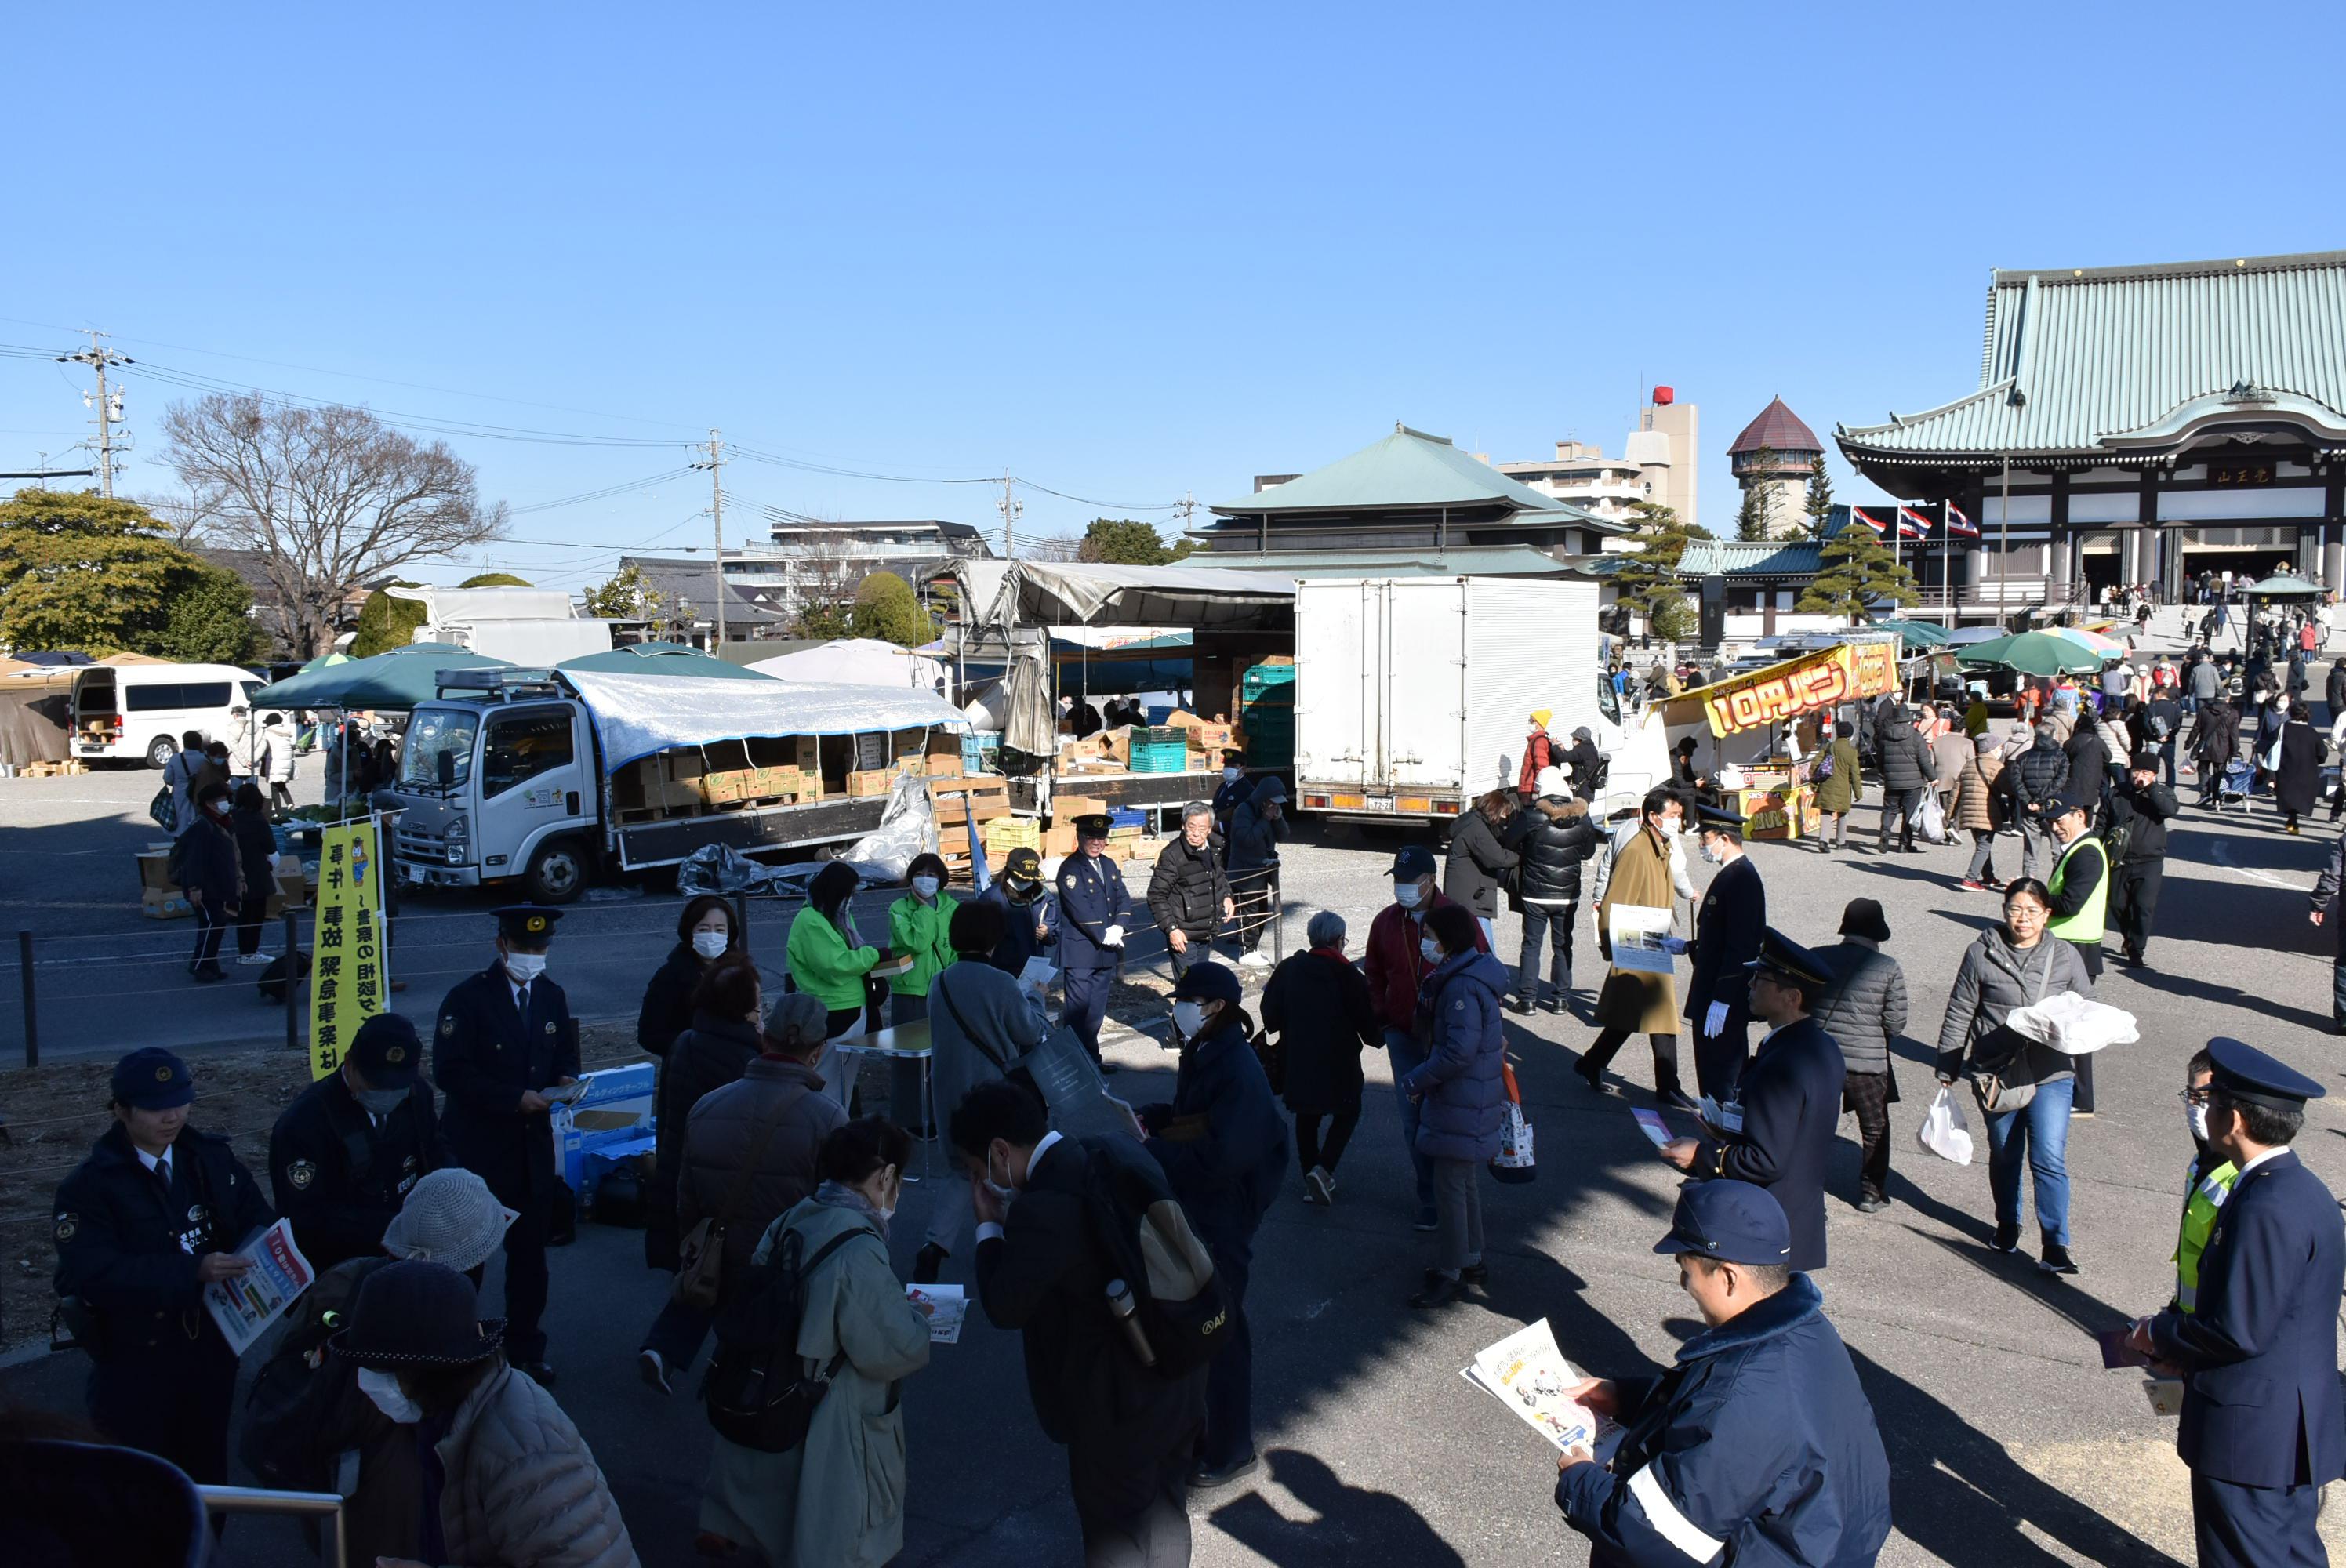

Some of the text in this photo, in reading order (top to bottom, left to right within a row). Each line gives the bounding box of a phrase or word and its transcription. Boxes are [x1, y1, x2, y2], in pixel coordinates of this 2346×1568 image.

[1712, 660, 1847, 732] 10円パン
[1746, 791, 1763, 800] SNS
[585, 1081, 650, 1099] ールディングテーブル
